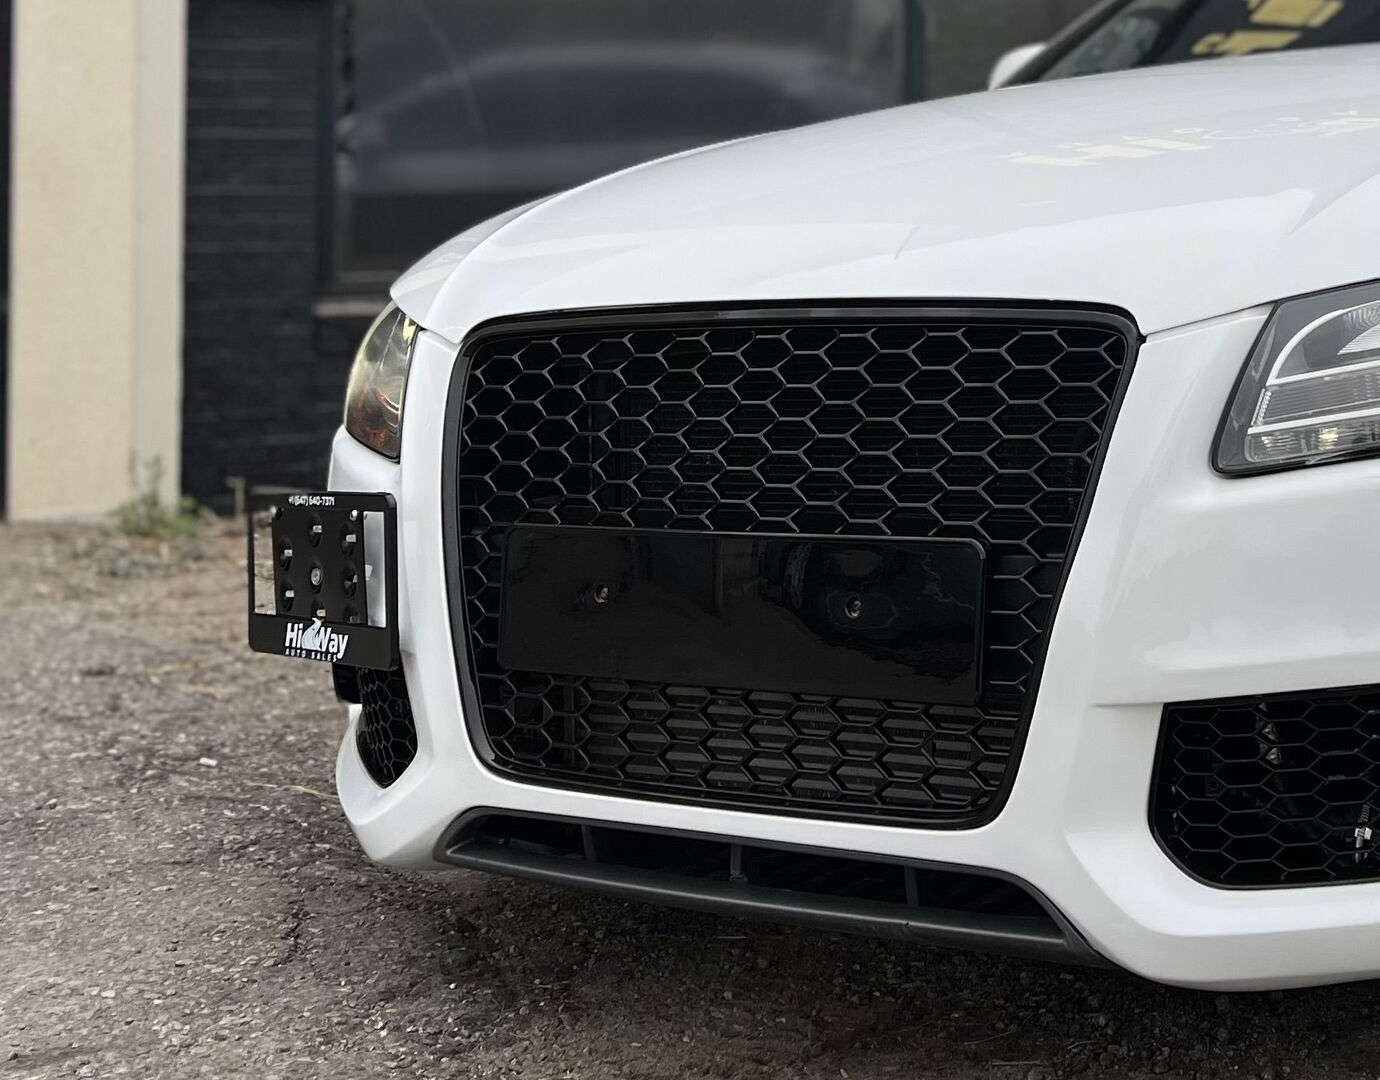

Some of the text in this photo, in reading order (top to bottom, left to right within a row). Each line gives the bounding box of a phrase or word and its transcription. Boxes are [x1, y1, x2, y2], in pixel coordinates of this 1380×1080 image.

[285, 622, 349, 660] Hi Way
[285, 648, 337, 663] AUTO SALES
